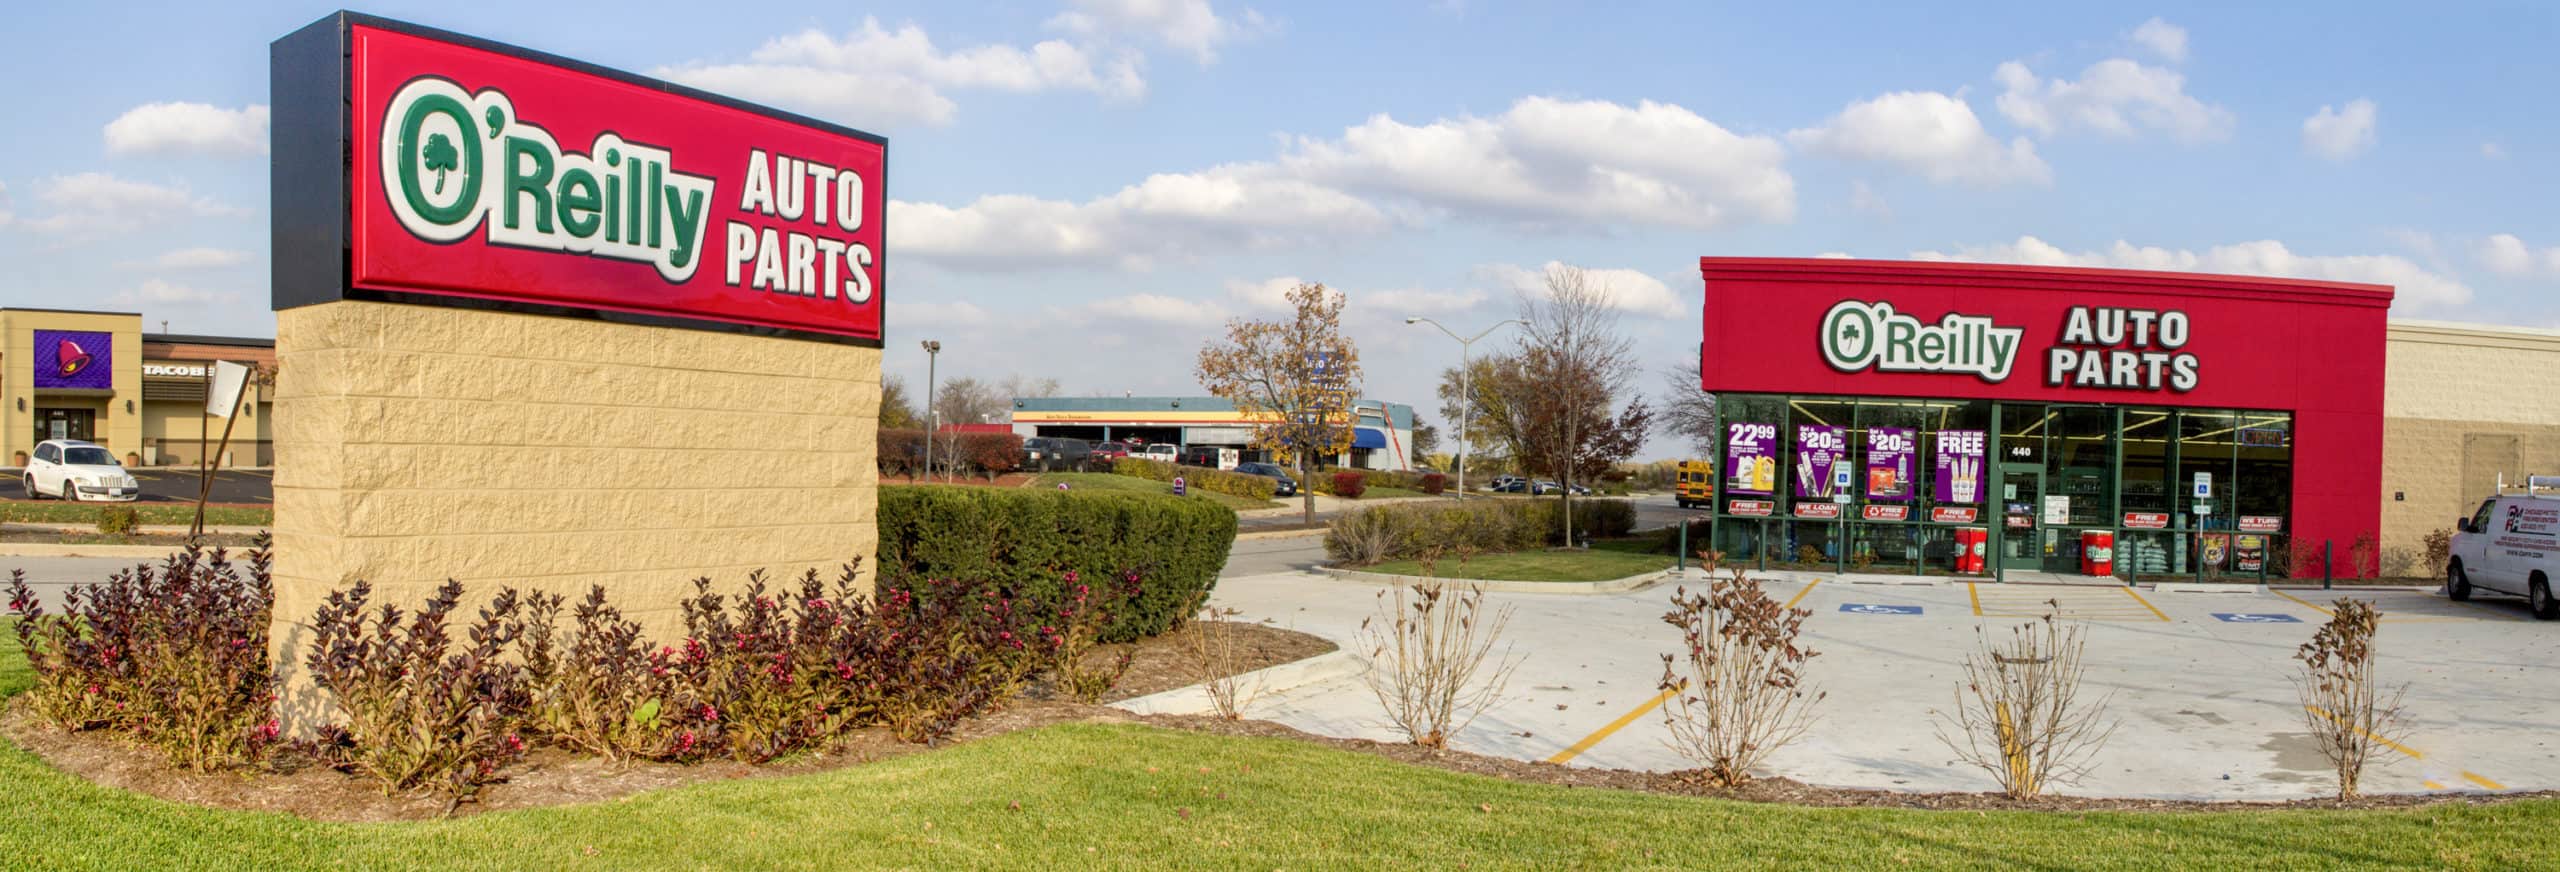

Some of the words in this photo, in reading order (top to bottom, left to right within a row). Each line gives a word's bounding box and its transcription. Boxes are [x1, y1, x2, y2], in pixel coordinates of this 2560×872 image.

[397, 90, 706, 271] O'Reilly
[740, 148, 864, 232] AUTO
[725, 220, 873, 304] PARTS
[1827, 305, 2015, 375] O'Reilly
[2063, 306, 2190, 348] AUTO
[143, 365, 189, 377] TACO
[2049, 347, 2199, 391] PARTS
[1800, 431, 1831, 448] $20
[1869, 434, 1901, 450] $20
[1938, 436, 1983, 454] FREE
[2012, 447, 2031, 456] 440
[1813, 503, 1838, 511] LOAN
